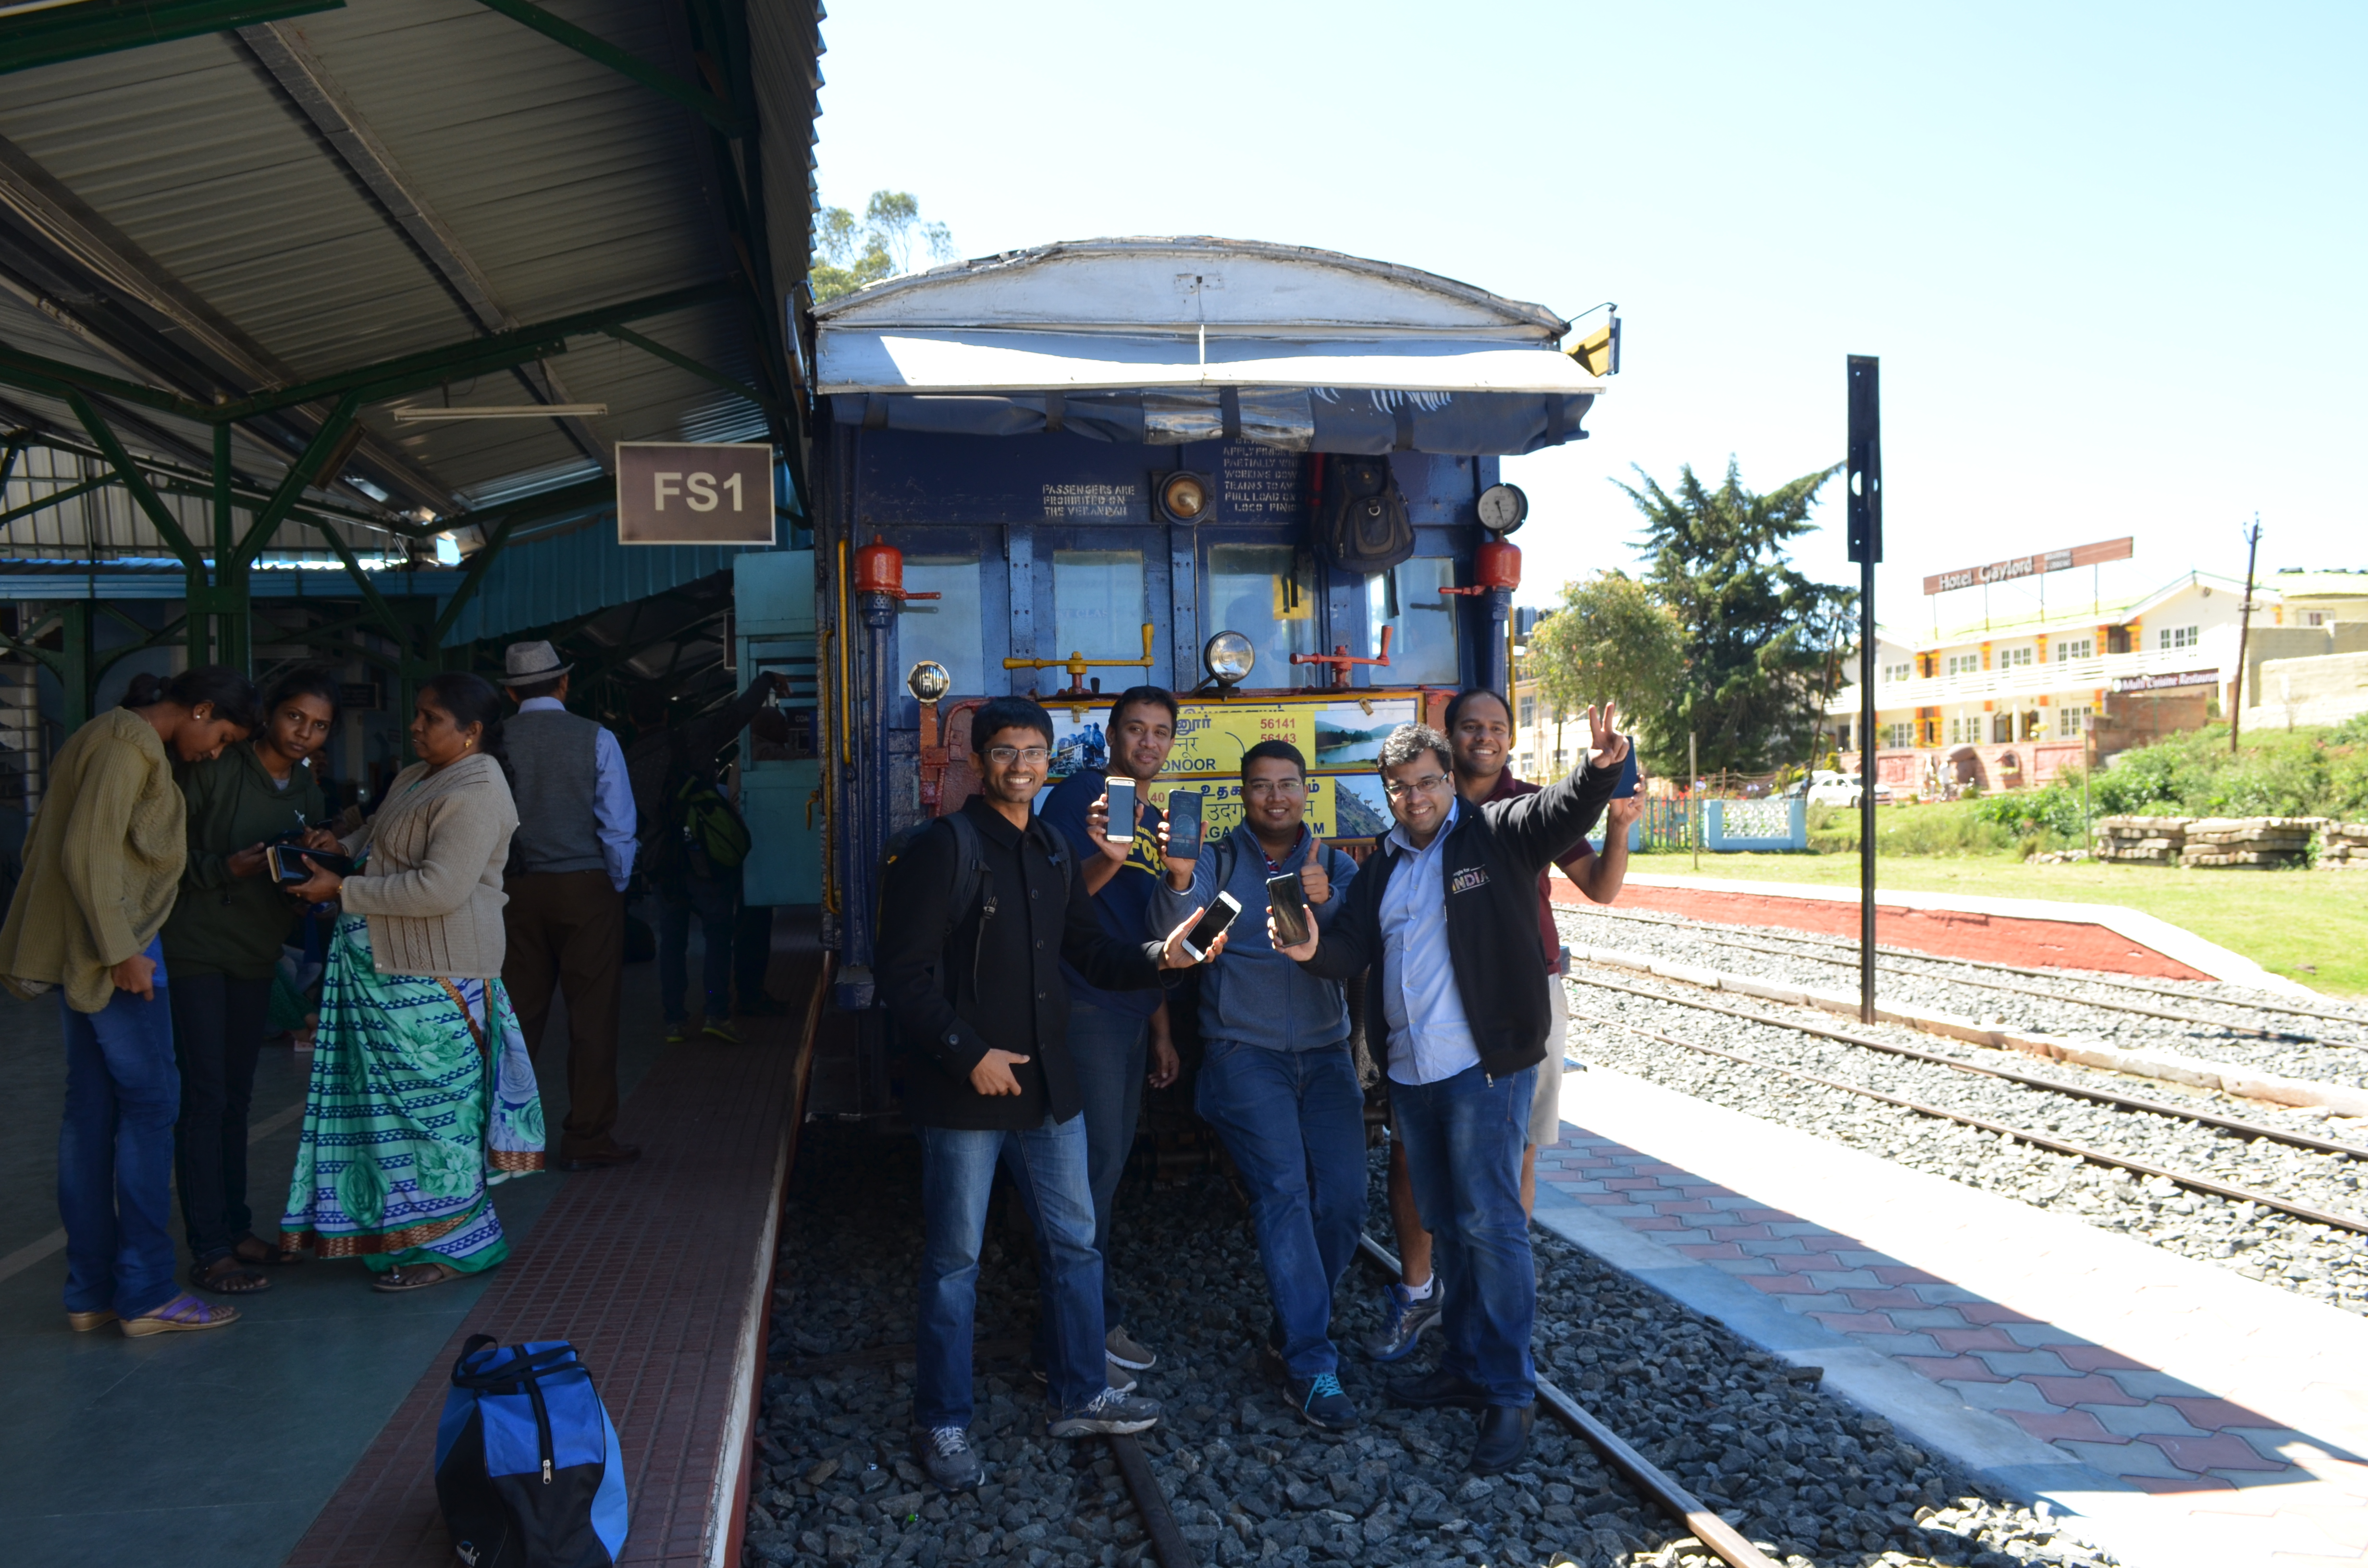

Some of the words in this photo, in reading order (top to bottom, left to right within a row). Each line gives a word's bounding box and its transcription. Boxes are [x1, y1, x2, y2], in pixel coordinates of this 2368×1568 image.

[1224, 459, 1275, 467] PARTIALLY
[1225, 470, 1271, 478] WORKING
[1275, 470, 1299, 478] DOW
[1043, 484, 1112, 495] PASSENGERS
[1115, 485, 1135, 495] ARE
[1224, 481, 1263, 490] TRAINS
[1266, 482, 1278, 490] TO
[654, 472, 743, 512] FS1
[1253, 492, 1279, 502] LOAD
[1044, 495, 1106, 505] PROHIBITED
[1109, 496, 1125, 505] ON
[1044, 506, 1064, 516] THE
[1067, 506, 1127, 516] VERANDAH
[1234, 503, 1263, 512] LOCO
[1270, 503, 1298, 512] PINIO
[1939, 570, 1972, 590] Hotel
[1978, 556, 2033, 583] Gaylord
[2179, 672, 2219, 686] Restauran
[795, 714, 810, 723] COA
[1260, 718, 1295, 729] 56141
[1260, 733, 1296, 743] 56143
[1159, 758, 1216, 772] ONOOR
[1452, 869, 1490, 892] INDIA
